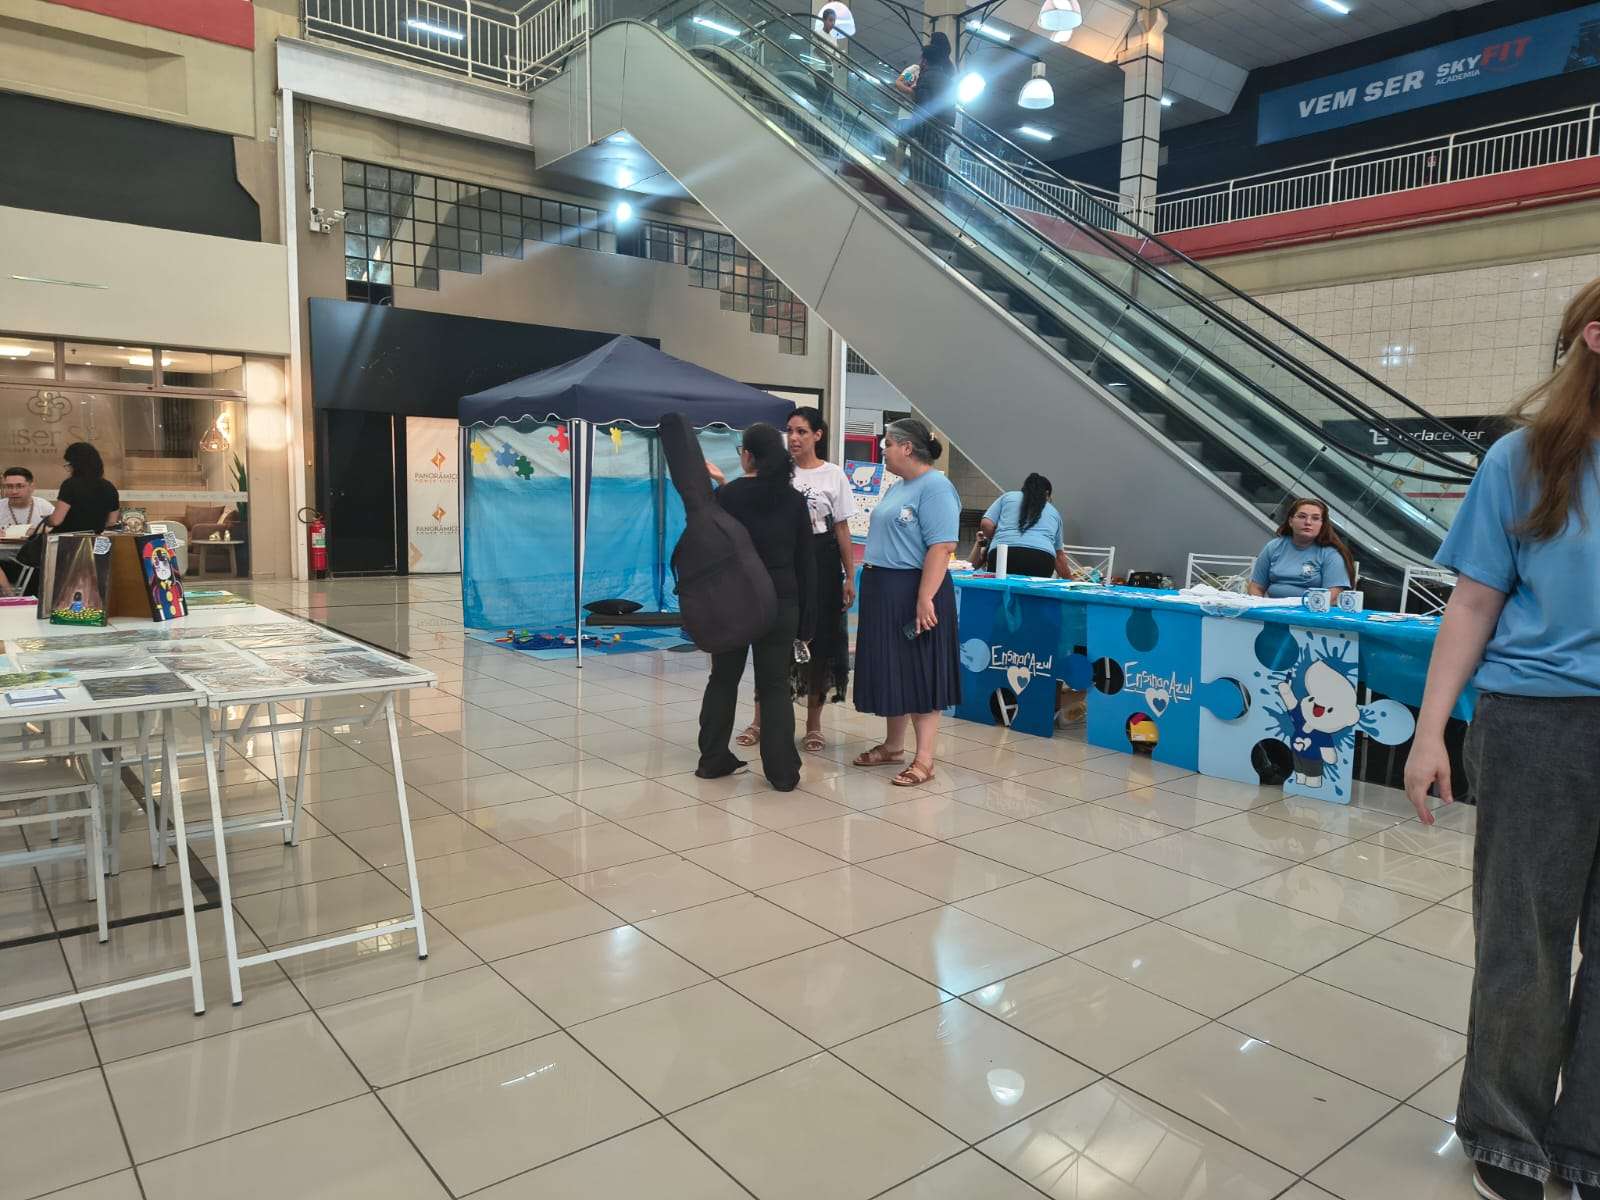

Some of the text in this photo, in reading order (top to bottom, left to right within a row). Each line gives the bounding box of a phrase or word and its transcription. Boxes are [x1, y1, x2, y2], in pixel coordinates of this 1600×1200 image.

[1435, 69, 1480, 86] ACADEMIA
[1299, 87, 1357, 118] VEM
[1363, 70, 1425, 102] SER
[1398, 429, 1486, 441] claceter
